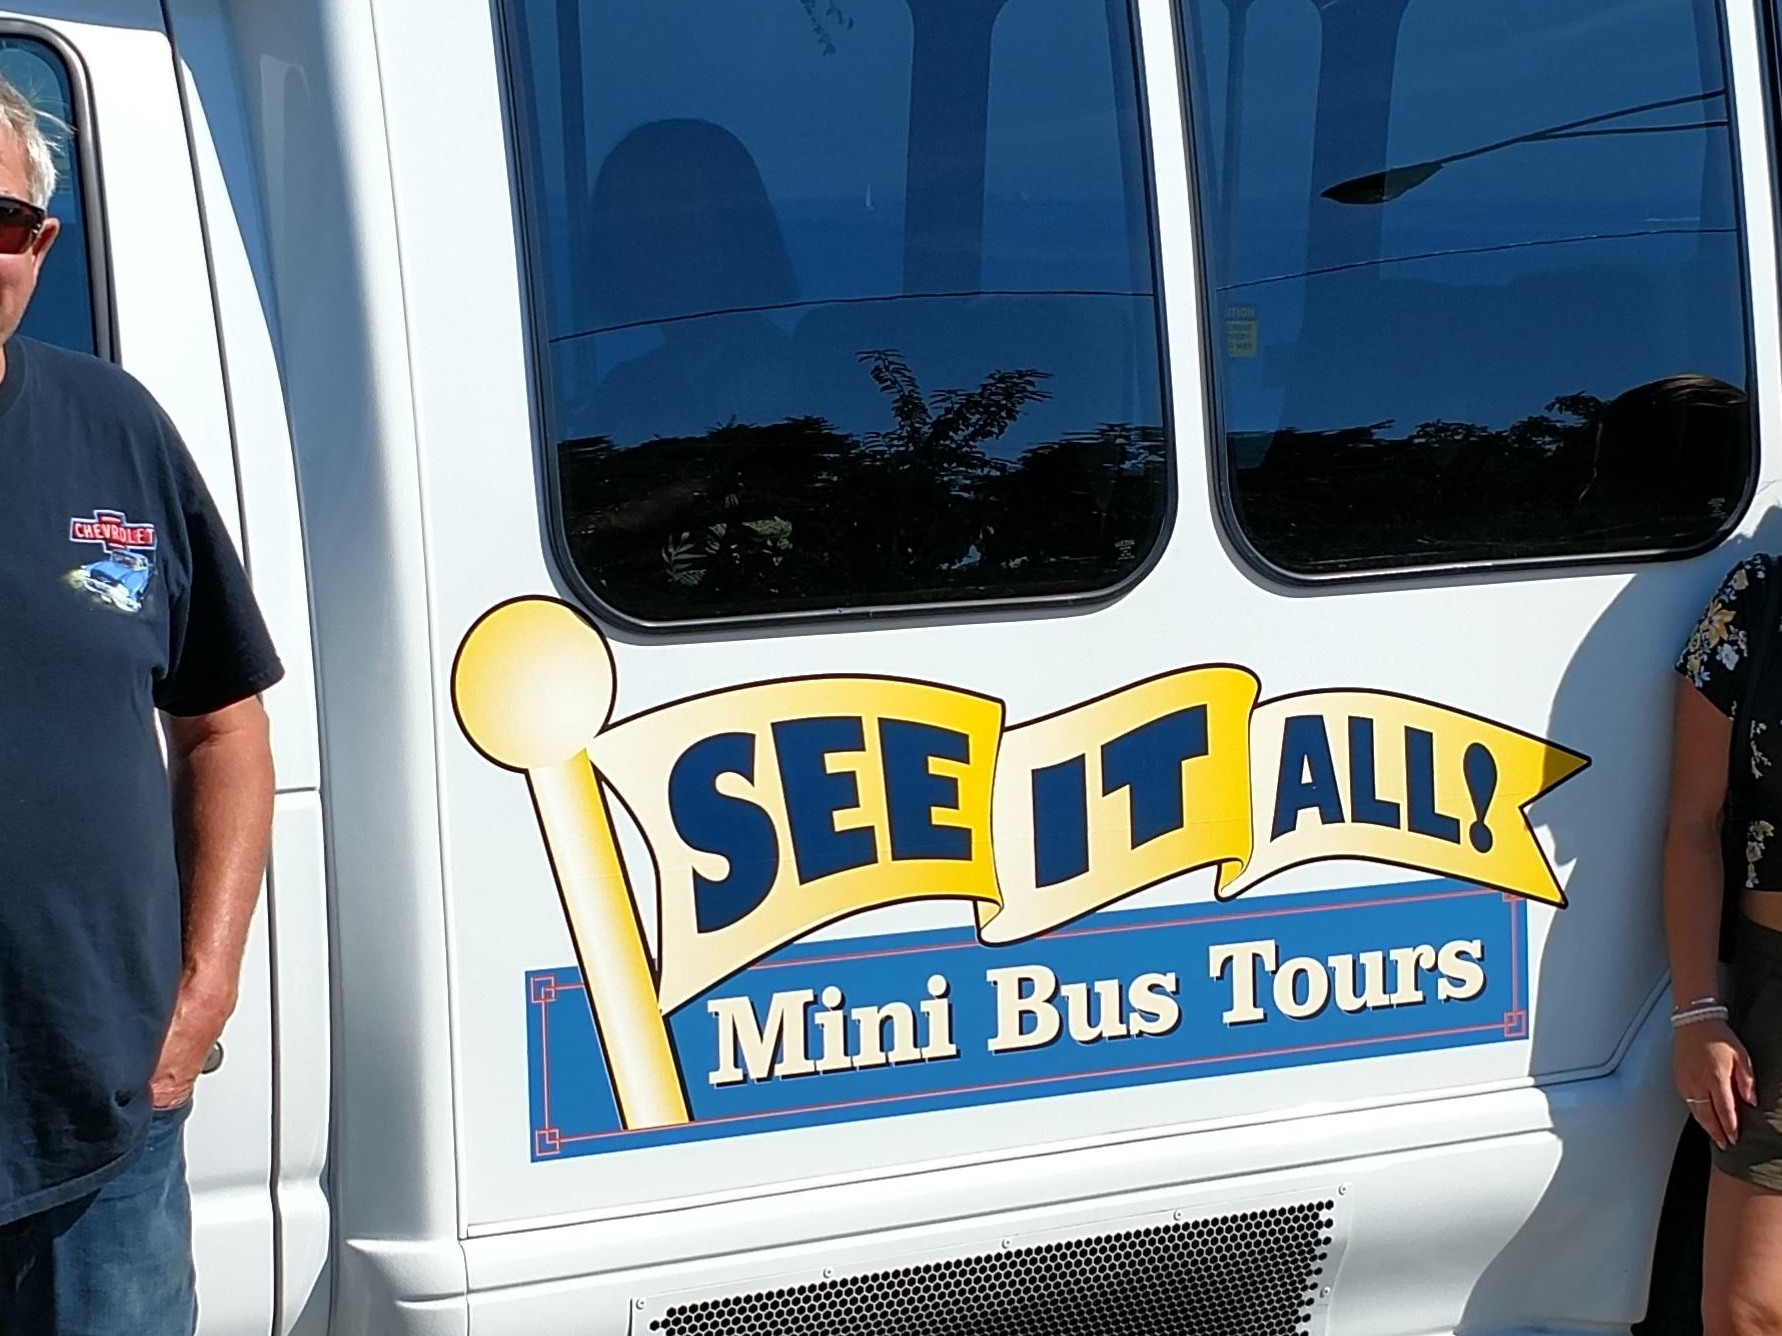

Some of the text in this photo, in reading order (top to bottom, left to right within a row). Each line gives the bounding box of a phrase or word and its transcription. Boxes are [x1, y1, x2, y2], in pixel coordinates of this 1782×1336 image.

[75, 523, 154, 544] CHEVROLET
[667, 704, 1500, 934] SEE IT ALL!
[707, 935, 1488, 1088] Mini Bus Tours
